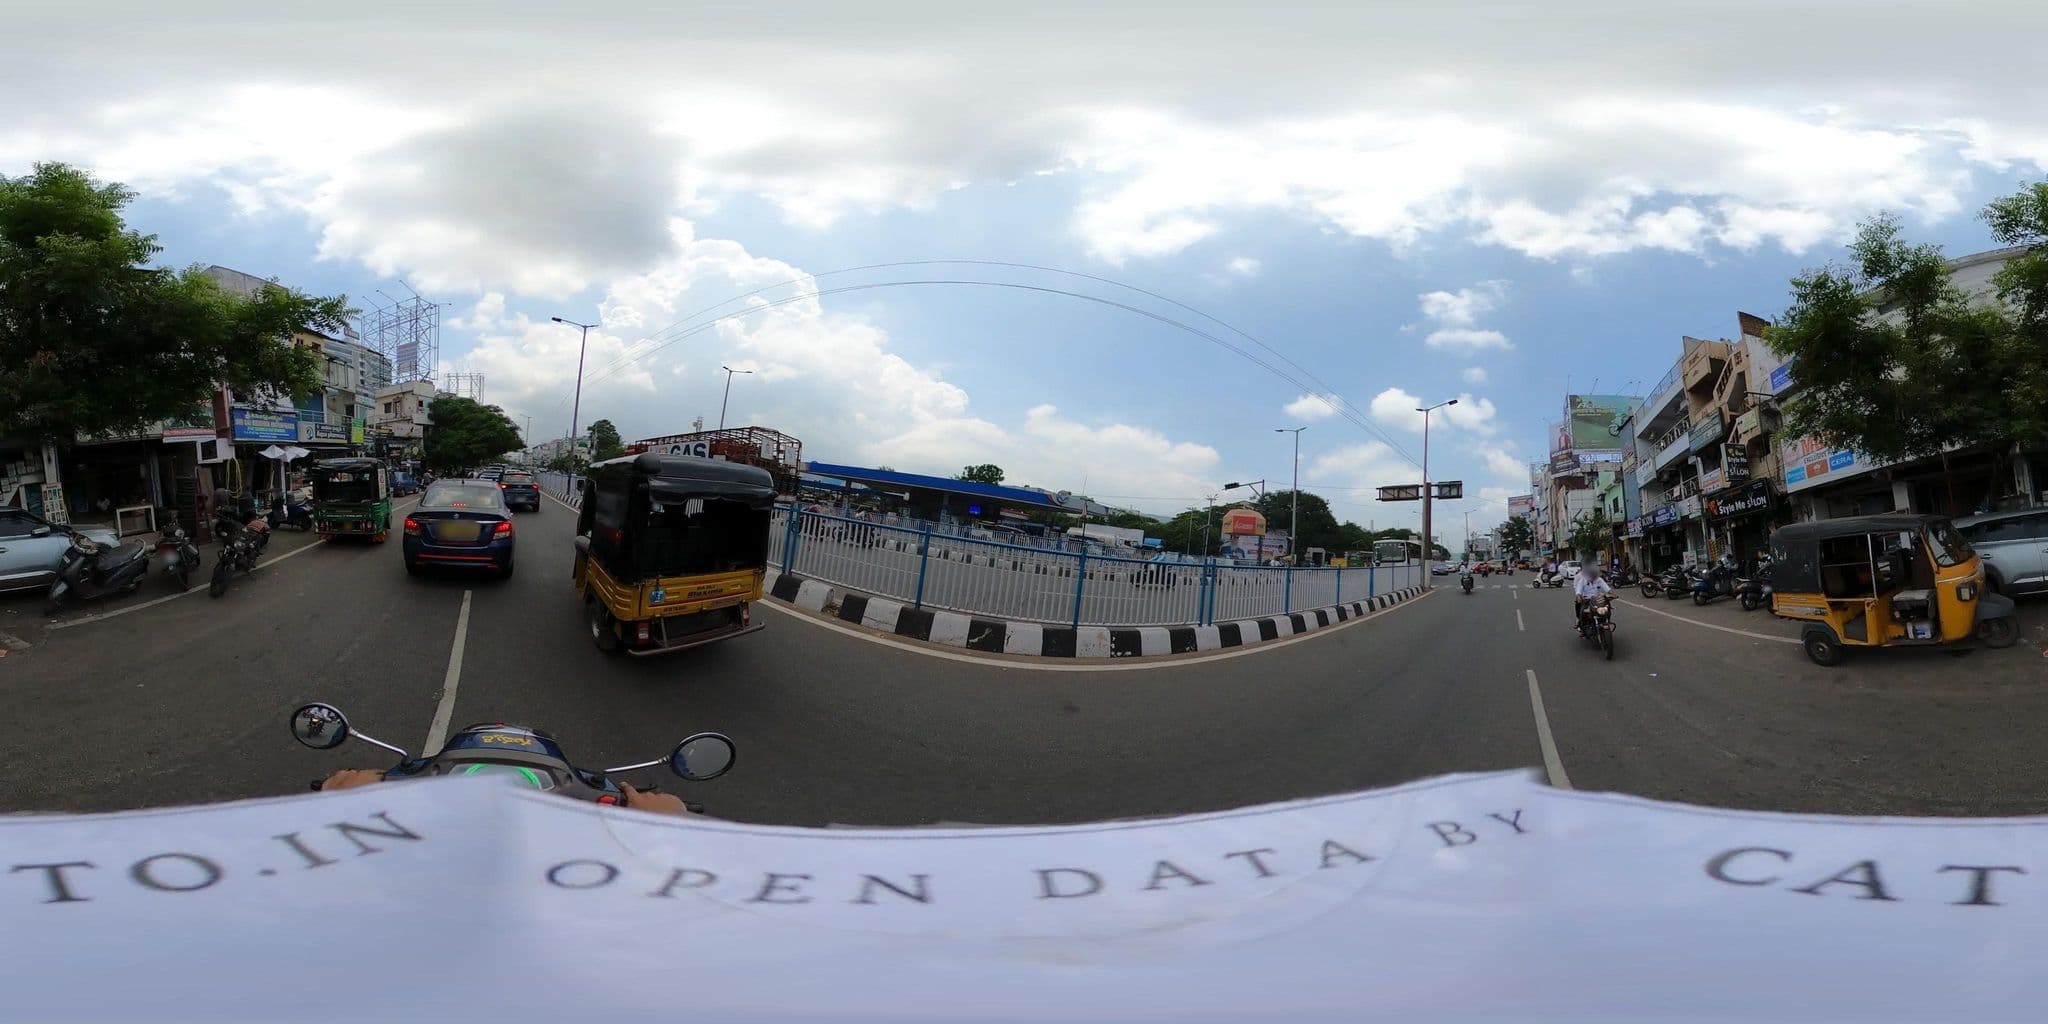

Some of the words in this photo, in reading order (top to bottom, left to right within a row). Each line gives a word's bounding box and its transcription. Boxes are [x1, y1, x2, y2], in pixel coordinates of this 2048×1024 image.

[1831, 455, 1852, 467] CERA
[1719, 503, 1735, 515] Style
[1735, 500, 1746, 511] Me
[10, 810, 424, 905] TO.IN
[545, 858, 932, 905] OPEN
[1034, 839, 1376, 900] DATA
[1426, 808, 1530, 848] BY
[1704, 846, 2029, 907] CAT
